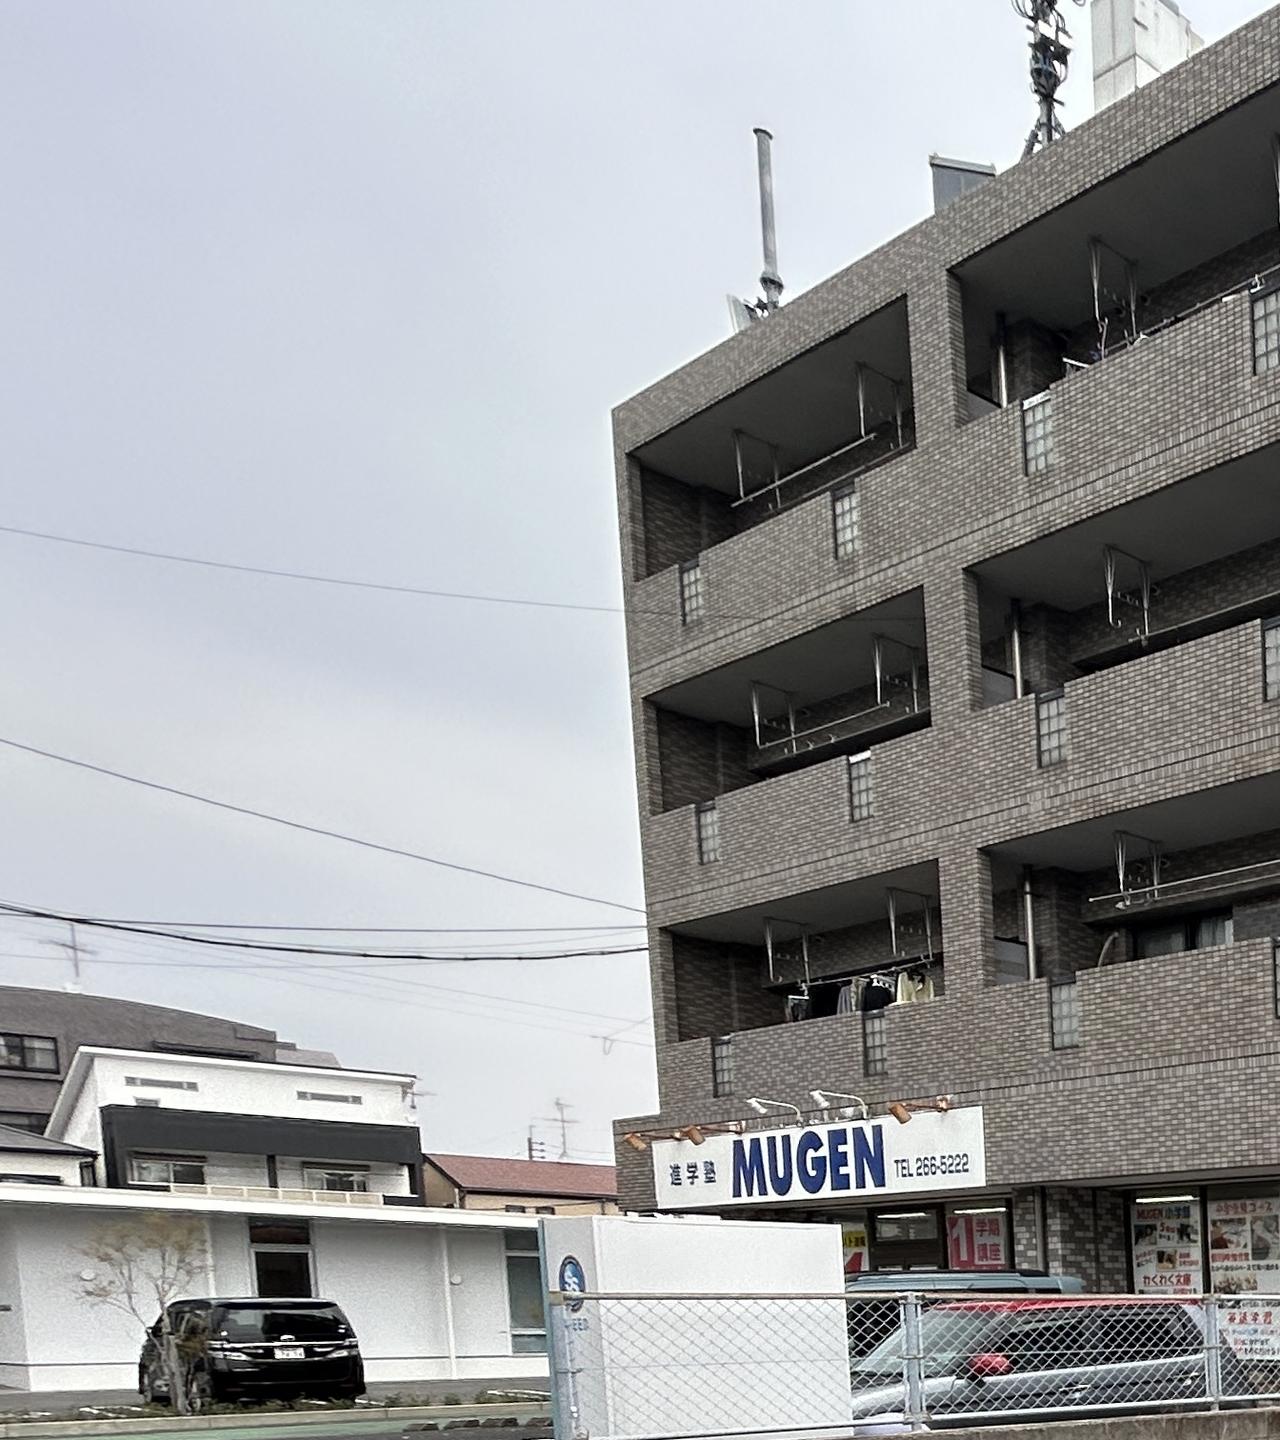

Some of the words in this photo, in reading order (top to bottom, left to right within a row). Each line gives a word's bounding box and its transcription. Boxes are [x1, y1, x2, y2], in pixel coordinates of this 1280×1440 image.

[669, 1160, 717, 1186] 進学塾
[731, 1124, 887, 1199] MUGEN
[894, 1158, 914, 1178] TEL
[915, 1153, 970, 1177] 266-5222
[951, 1217, 969, 1262] 1
[975, 1217, 1001, 1238] 学期
